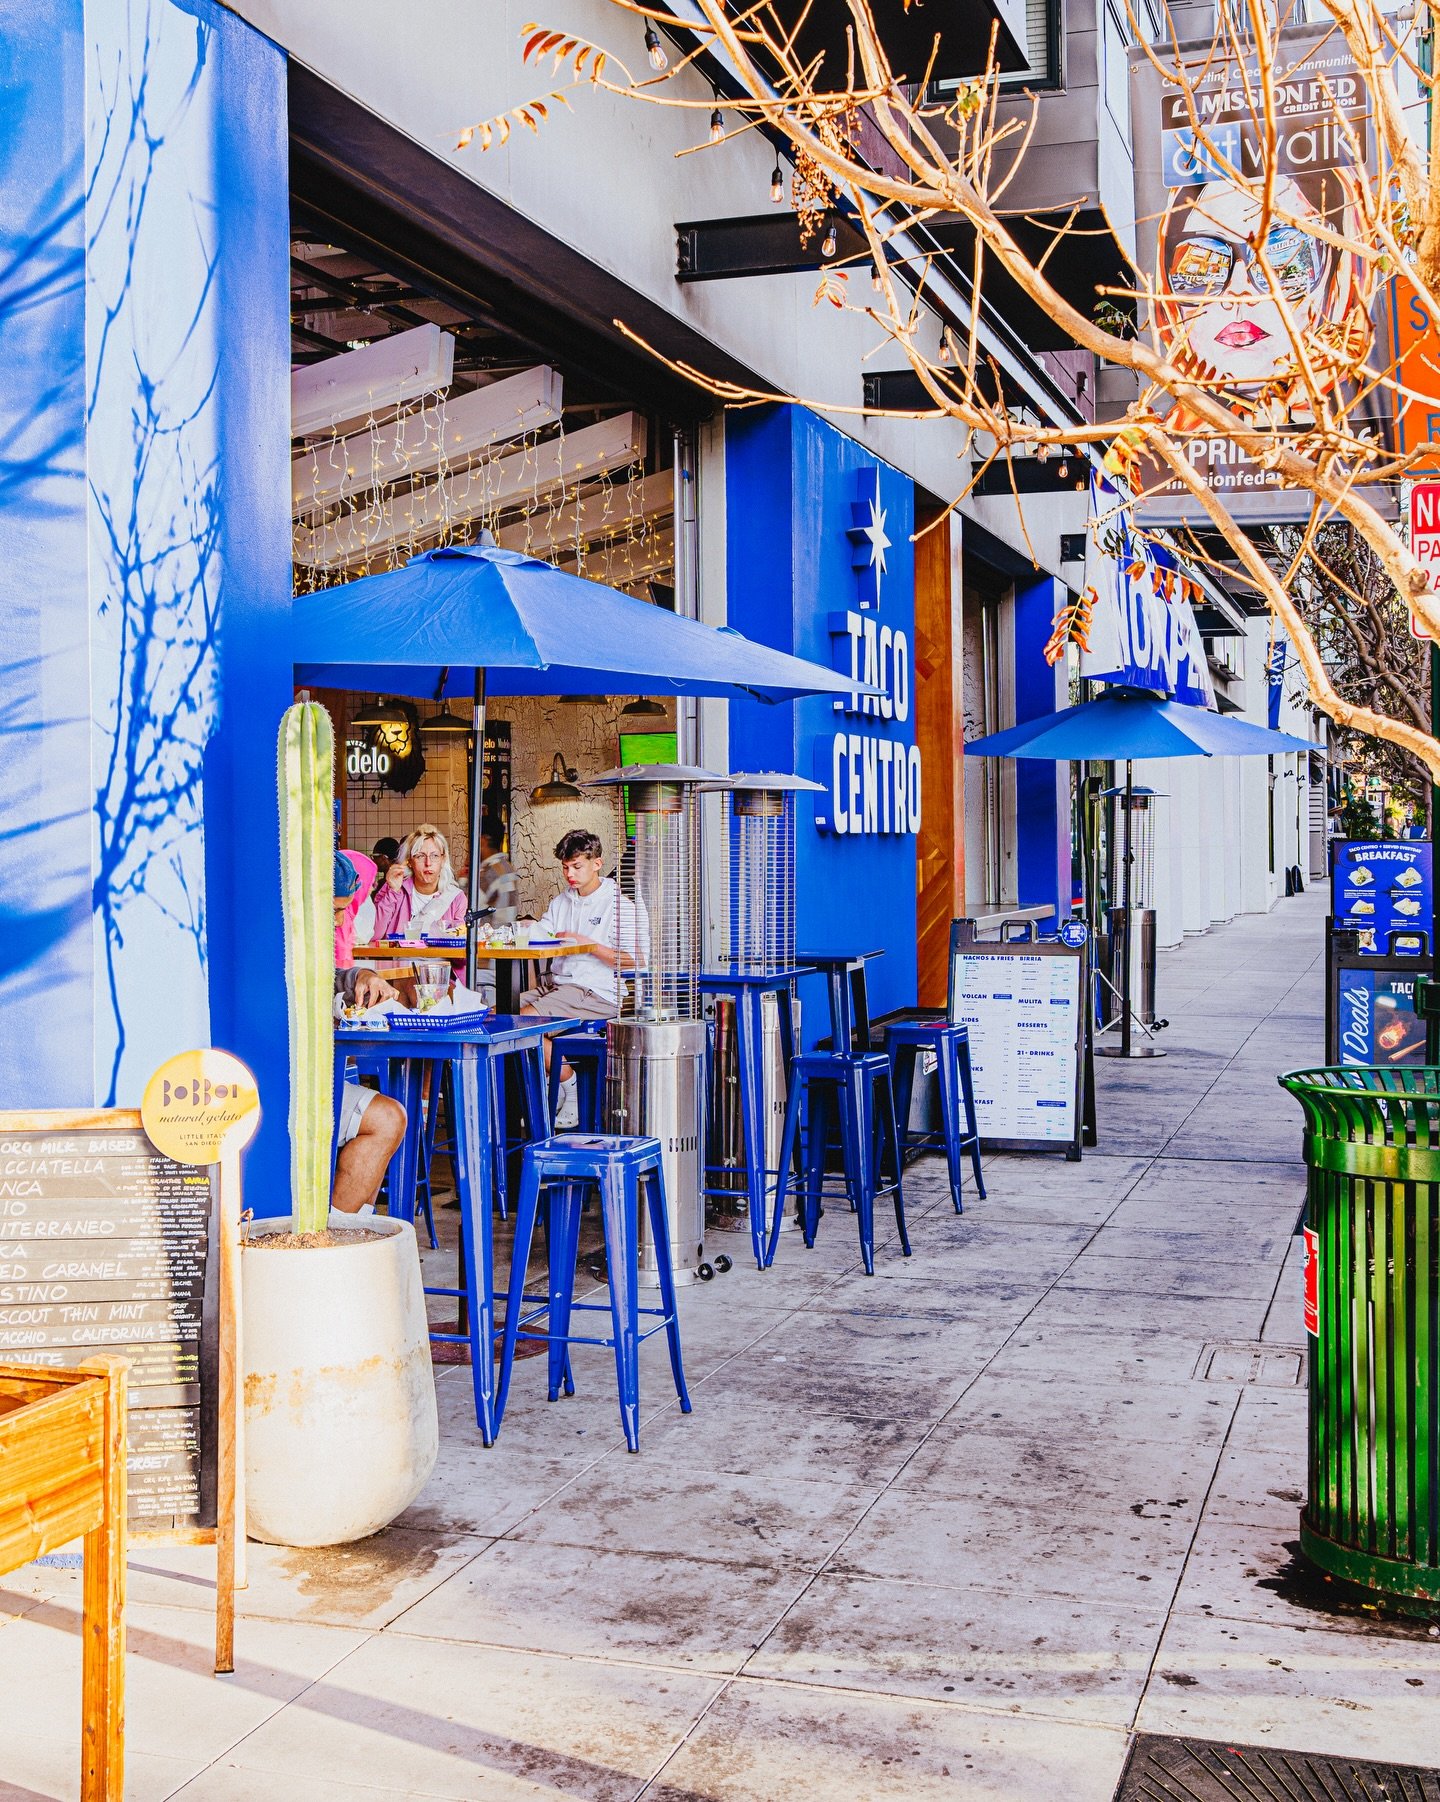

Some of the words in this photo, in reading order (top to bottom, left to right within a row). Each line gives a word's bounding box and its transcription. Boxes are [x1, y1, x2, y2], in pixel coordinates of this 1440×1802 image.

[1162, 71, 1227, 88] Cnecting
[1233, 63, 1283, 80] Ceave
[1287, 54, 1358, 71] Communiti
[1309, 78, 1356, 101] FED
[1283, 102, 1319, 114] CREDIT
[847, 610, 908, 722] TACO
[347, 746, 390, 774] delo
[833, 732, 922, 834] CENTRO
[1355, 851, 1416, 863] BREAKFAST
[1343, 986, 1369, 1055] Deals
[159, 1111, 205, 1125] natural
[205, 1110, 241, 1125] gelato
[0, 1141, 32, 1155] ORG
[40, 1141, 78, 1154] MILK
[88, 1140, 137, 1153] BASED
[0, 1159, 105, 1175] CCIATELLA
[42, 1262, 128, 1279] CARAMEL
[0, 1307, 53, 1324] SCOUT
[60, 1306, 98, 1322] THIN
[109, 1303, 149, 1320] MINT
[72, 1326, 154, 1342] CALIFORNIA
[126, 1455, 175, 1471] ORBET
